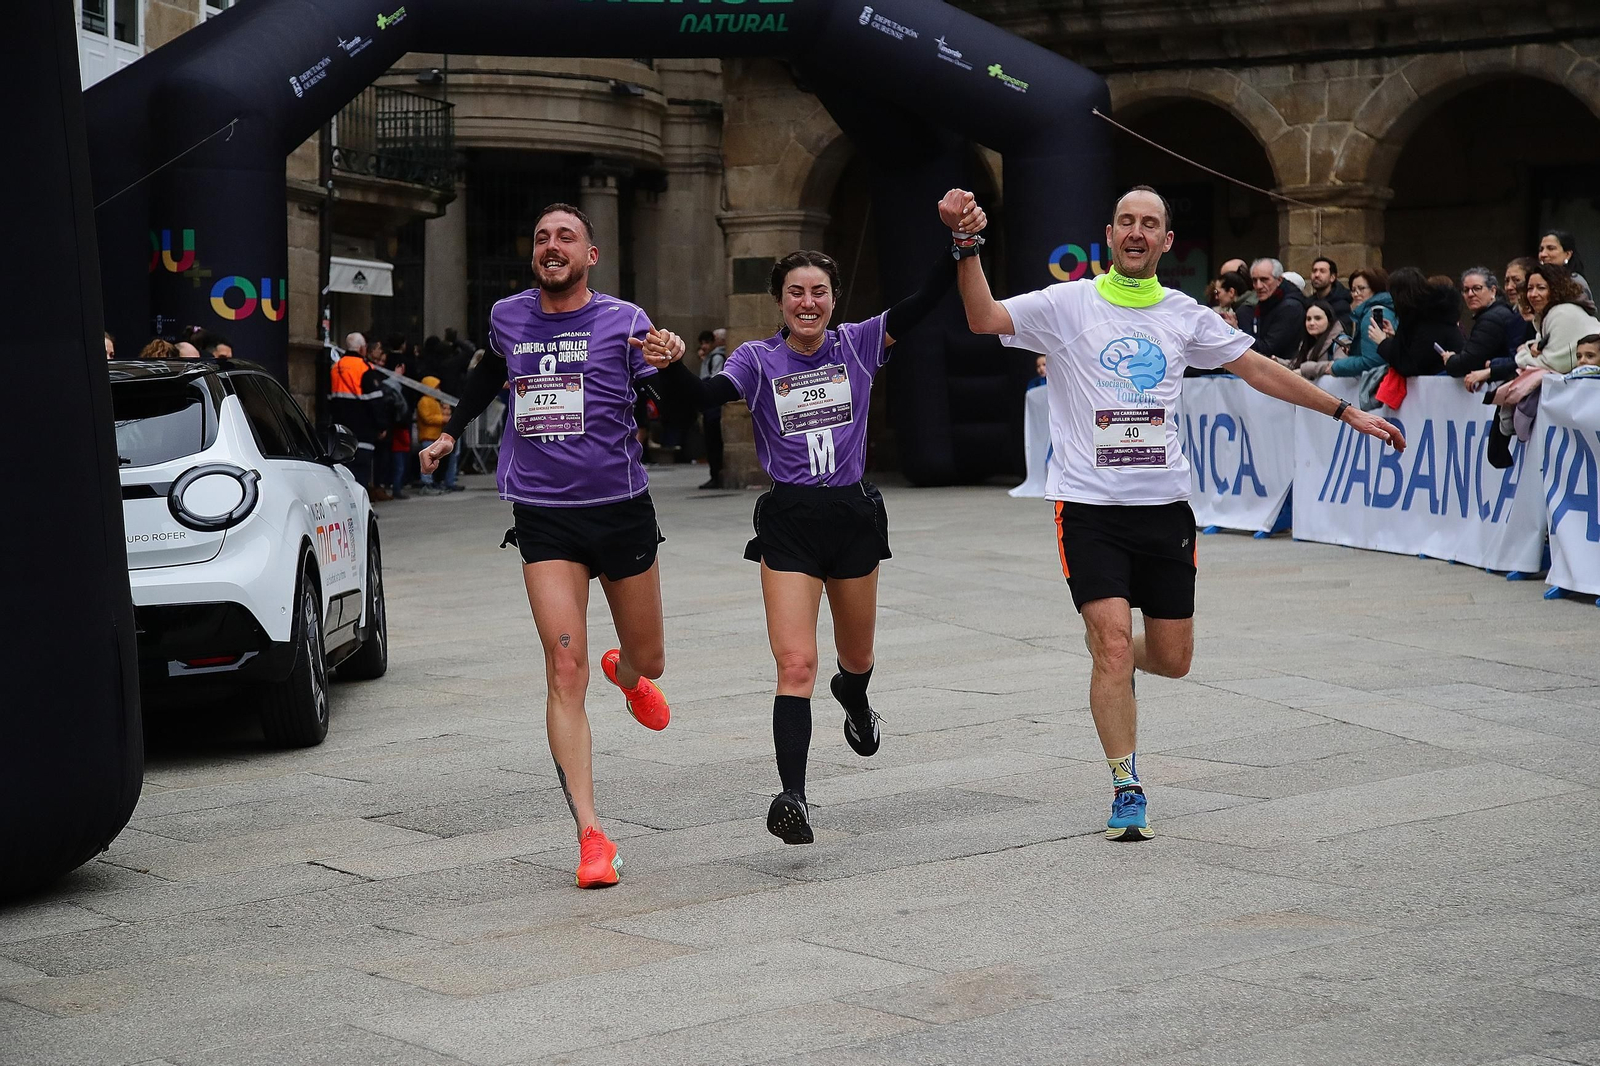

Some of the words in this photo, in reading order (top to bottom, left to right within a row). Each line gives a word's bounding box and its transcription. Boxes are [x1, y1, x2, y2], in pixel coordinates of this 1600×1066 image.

[871, 21, 904, 40] OURENSE
[874, 14, 919, 38] DEPUTACIÓN
[299, 56, 331, 82] DEPUTACIÓN
[303, 70, 326, 90] OURENSE
[513, 342, 546, 355] CARREIRA
[547, 342, 557, 352] DA
[559, 340, 588, 351] MULLER
[558, 350, 588, 362] OURENSE
[791, 380, 809, 388] MULLER
[810, 376, 830, 384] OURENSE
[798, 372, 820, 380] CARREIRA
[1096, 380, 1134, 389] Asociación
[534, 394, 557, 406] 472
[802, 388, 826, 402] 298
[1125, 427, 1139, 438] 40
[806, 429, 835, 476] M
[1174, 413, 1268, 497] NCA
[127, 535, 149, 543] UPO
[152, 532, 186, 541] ROFER
